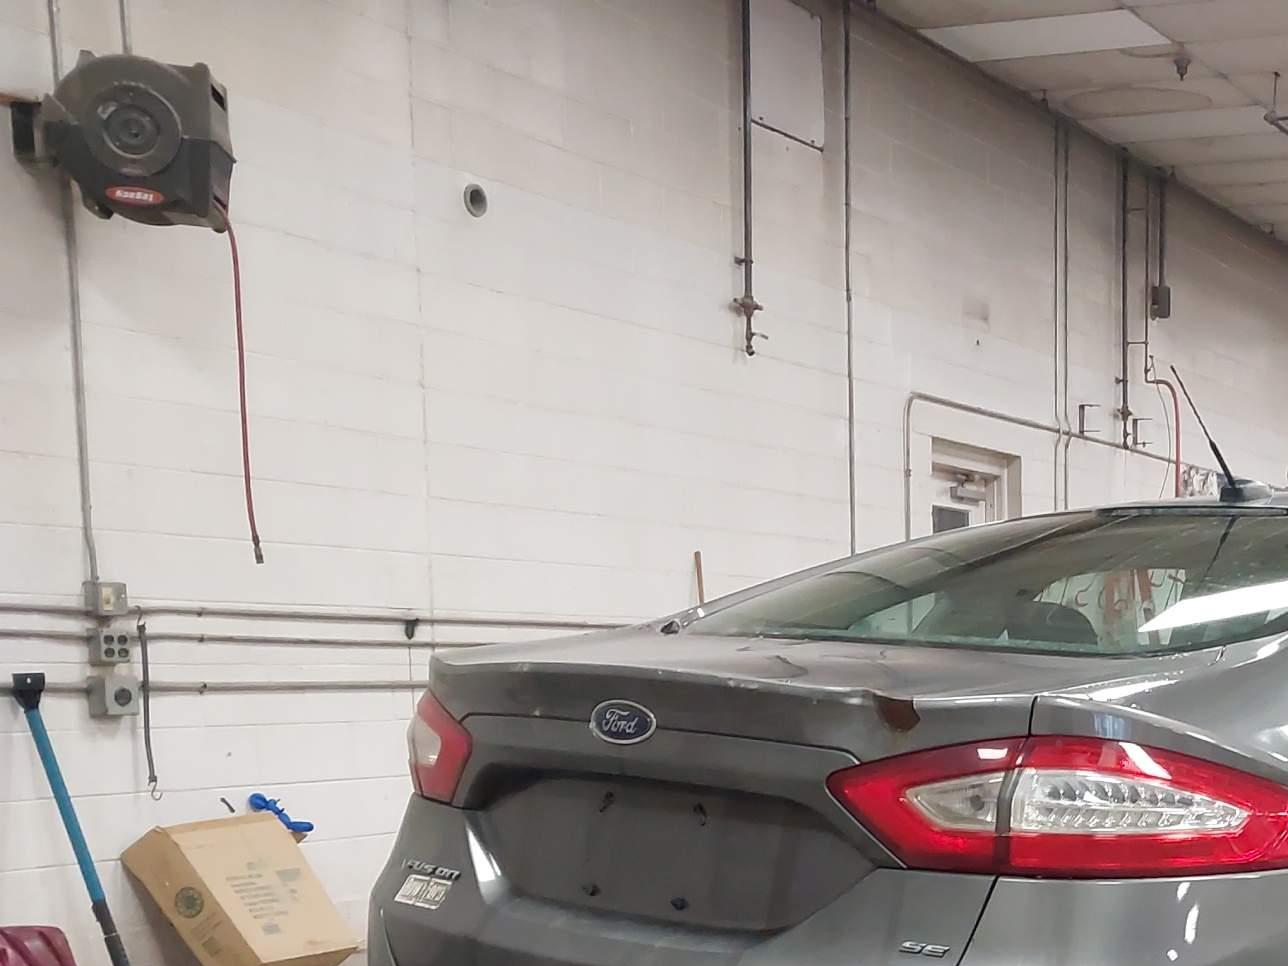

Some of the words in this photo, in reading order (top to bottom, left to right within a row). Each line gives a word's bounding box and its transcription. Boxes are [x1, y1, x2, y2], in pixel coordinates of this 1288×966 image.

[602, 708, 639, 734] Ford
[407, 859, 461, 880] FUSON
[899, 941, 951, 958] SE
